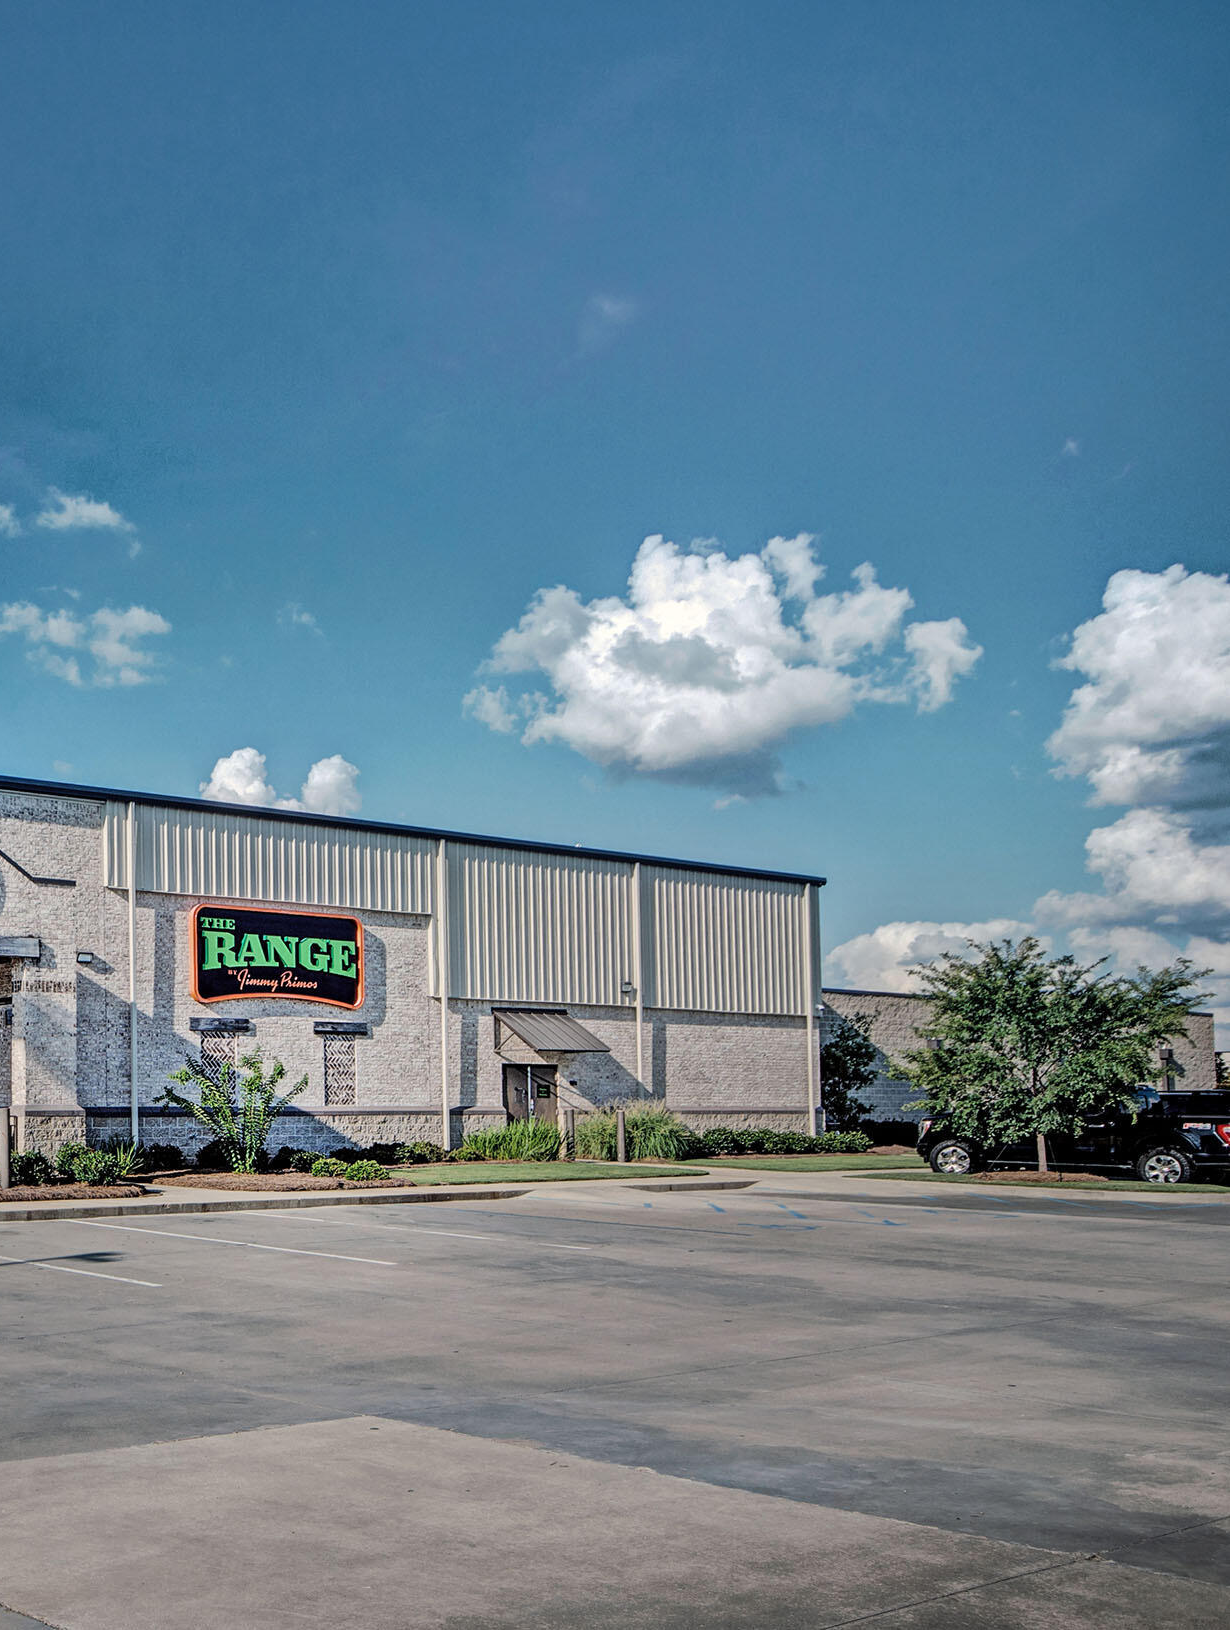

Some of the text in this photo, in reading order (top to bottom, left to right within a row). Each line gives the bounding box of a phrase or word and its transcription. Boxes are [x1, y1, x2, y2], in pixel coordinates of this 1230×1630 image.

[200, 917, 236, 930] THE
[202, 930, 356, 979] RANGE
[237, 968, 278, 992] Jimmy
[280, 970, 318, 989] Primos
